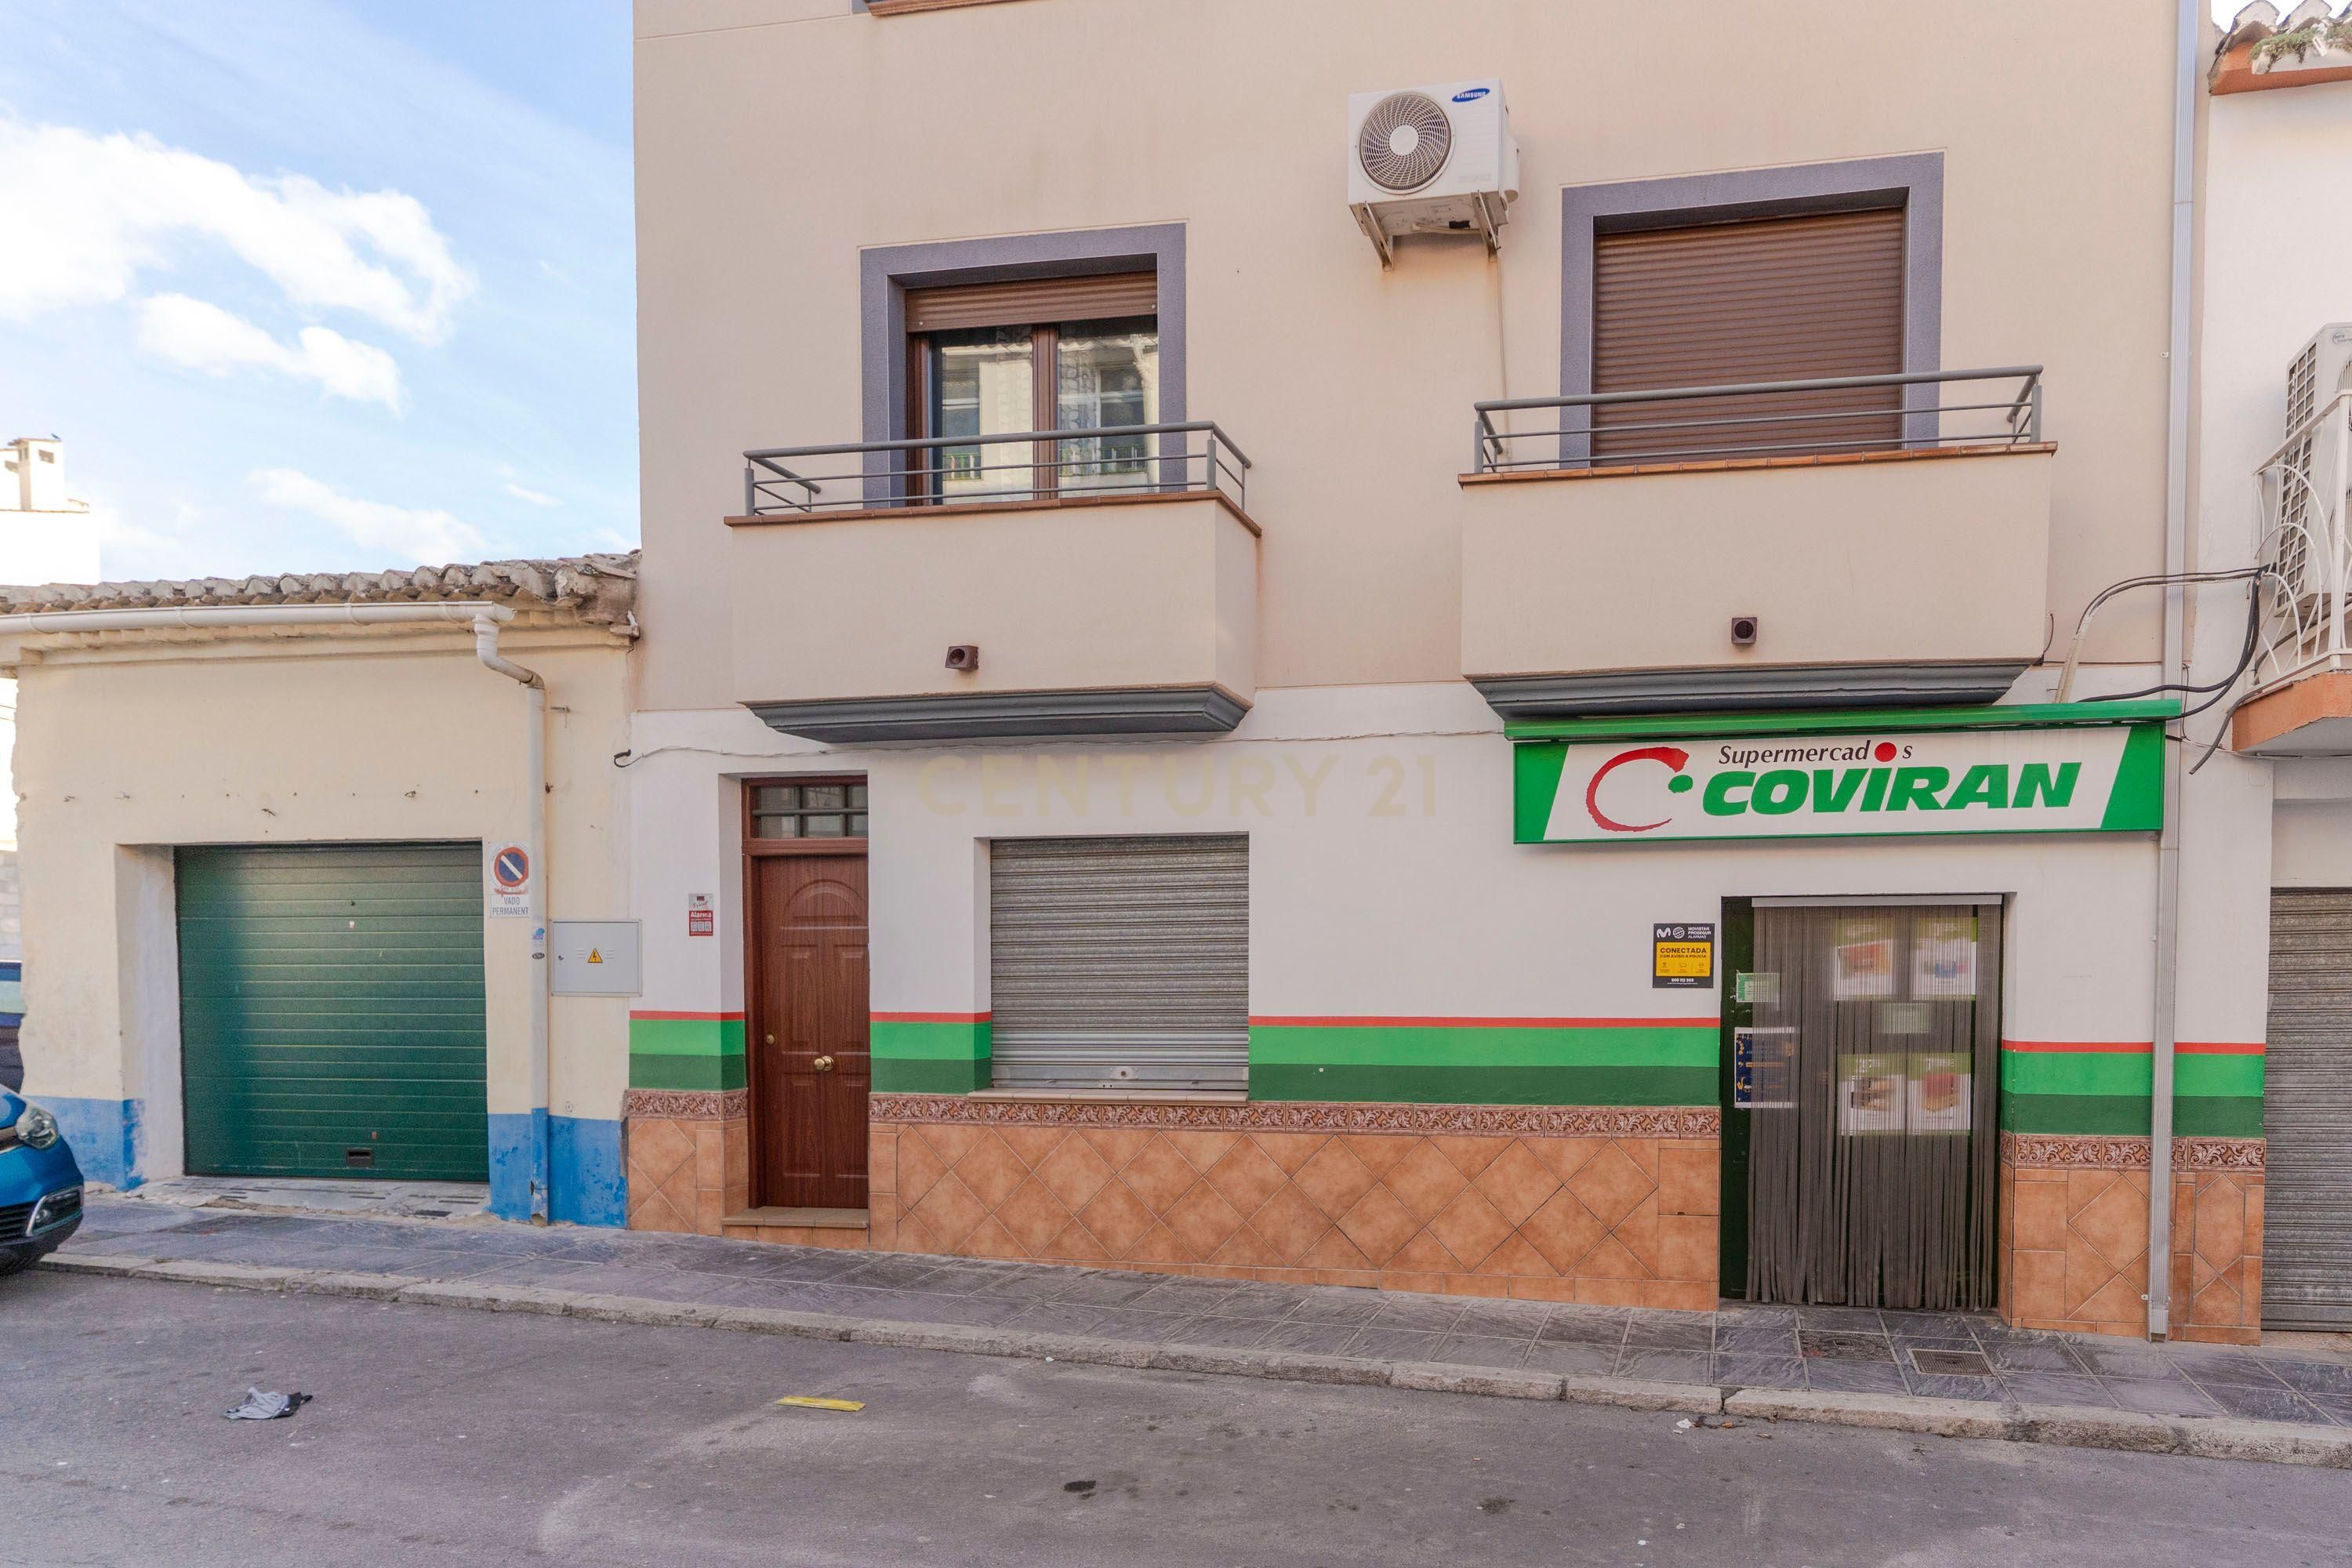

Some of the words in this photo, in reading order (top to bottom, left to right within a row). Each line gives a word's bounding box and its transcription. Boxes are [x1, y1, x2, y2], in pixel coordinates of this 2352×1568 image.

[1456, 91, 1486, 100] SAMSUNG
[1702, 761, 2082, 816] COVIRAN
[503, 896, 521, 905] VADO
[492, 906, 529, 916] PERMANENT
